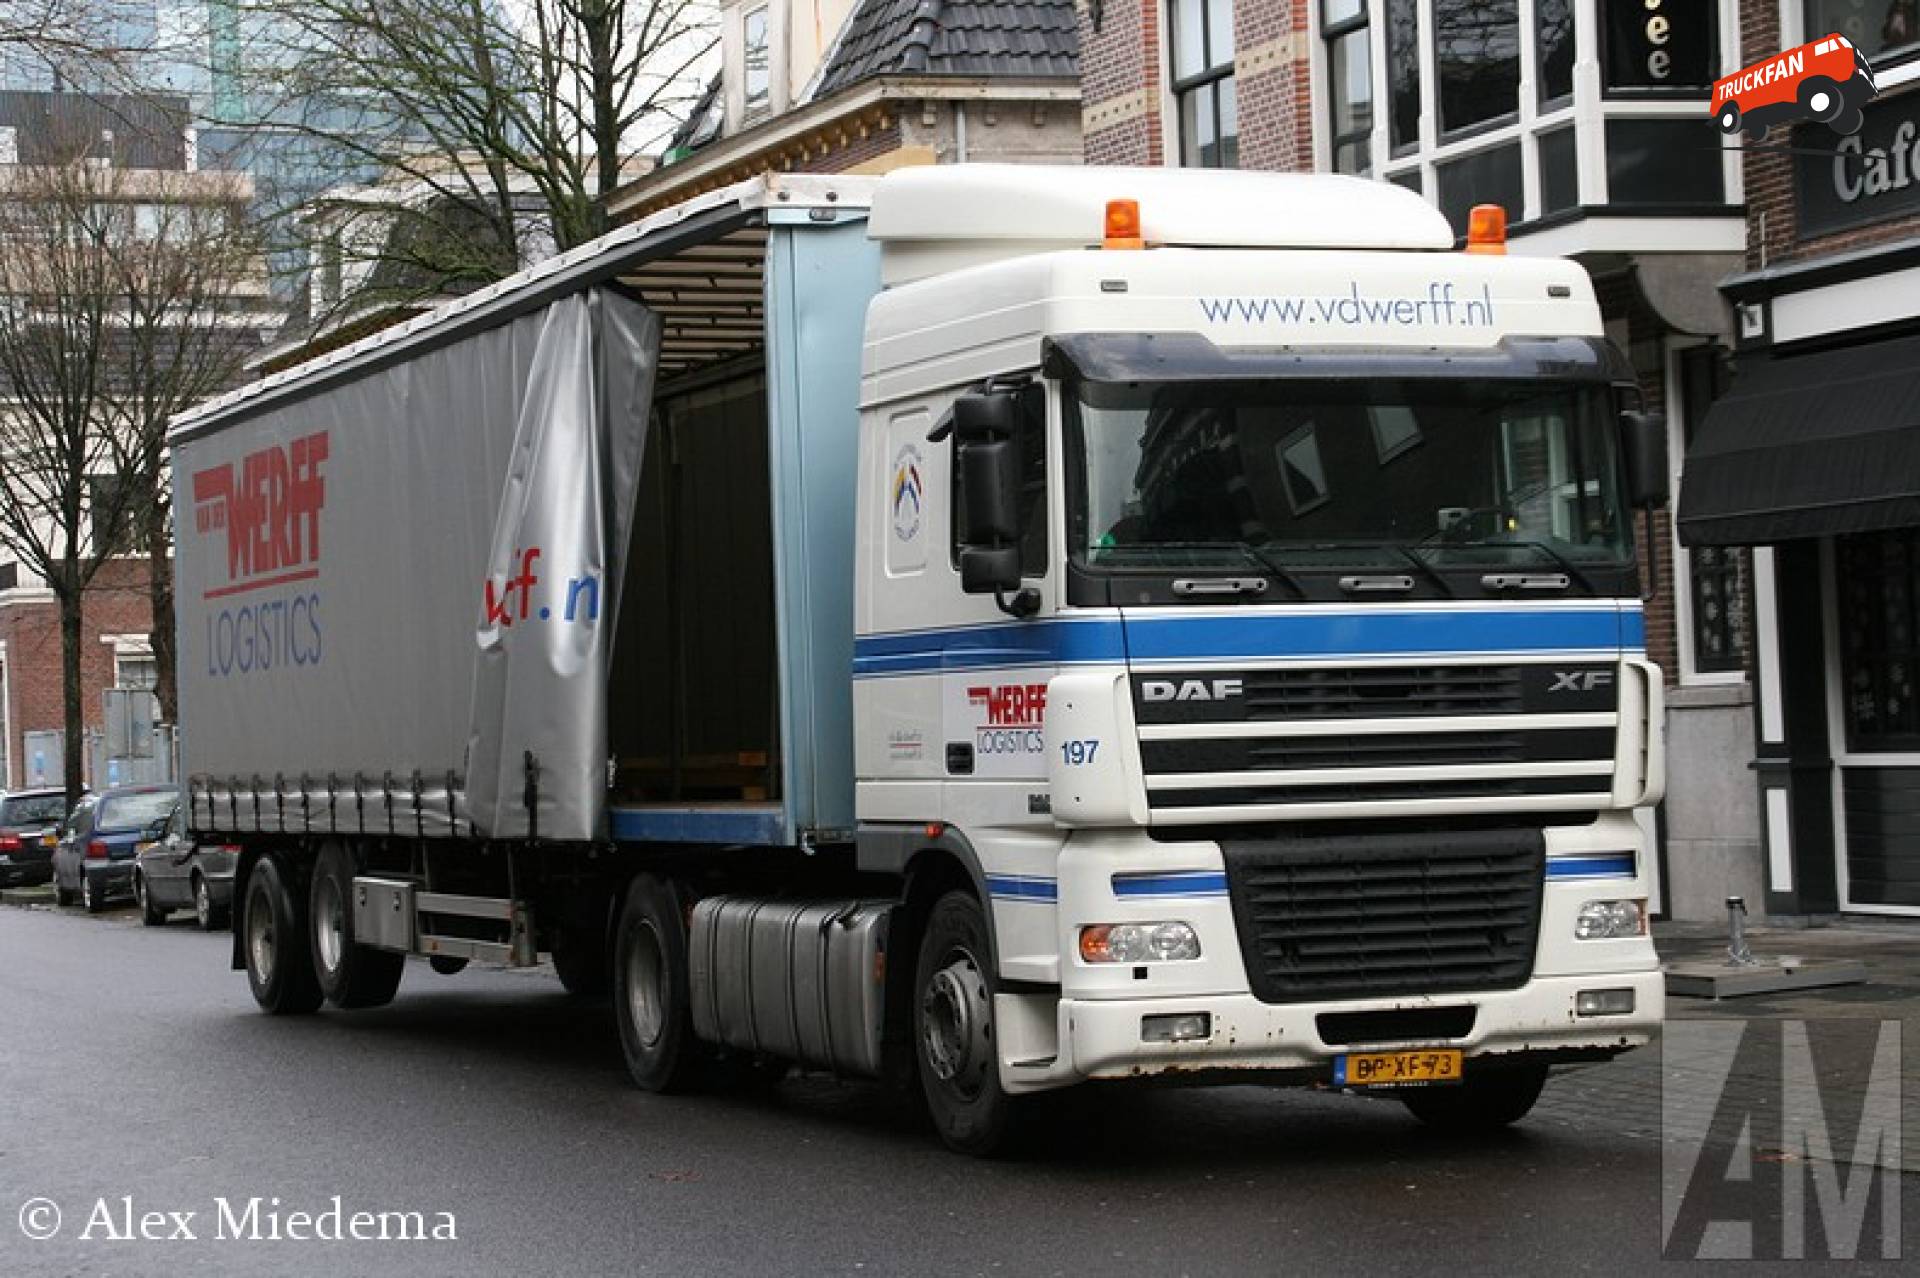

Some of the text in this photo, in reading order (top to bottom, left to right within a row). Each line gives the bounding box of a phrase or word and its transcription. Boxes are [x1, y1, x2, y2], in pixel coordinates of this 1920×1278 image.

[1200, 281, 1493, 325] www.vdwerff.nl
[193, 430, 328, 580] WERFF
[207, 593, 321, 677] LOGISTICS
[1141, 679, 1243, 701] DAF
[1548, 671, 1613, 691] XF
[967, 684, 1048, 725] WERFF
[976, 730, 1044, 754] LOGISTICS
[1062, 740, 1099, 765] 197
